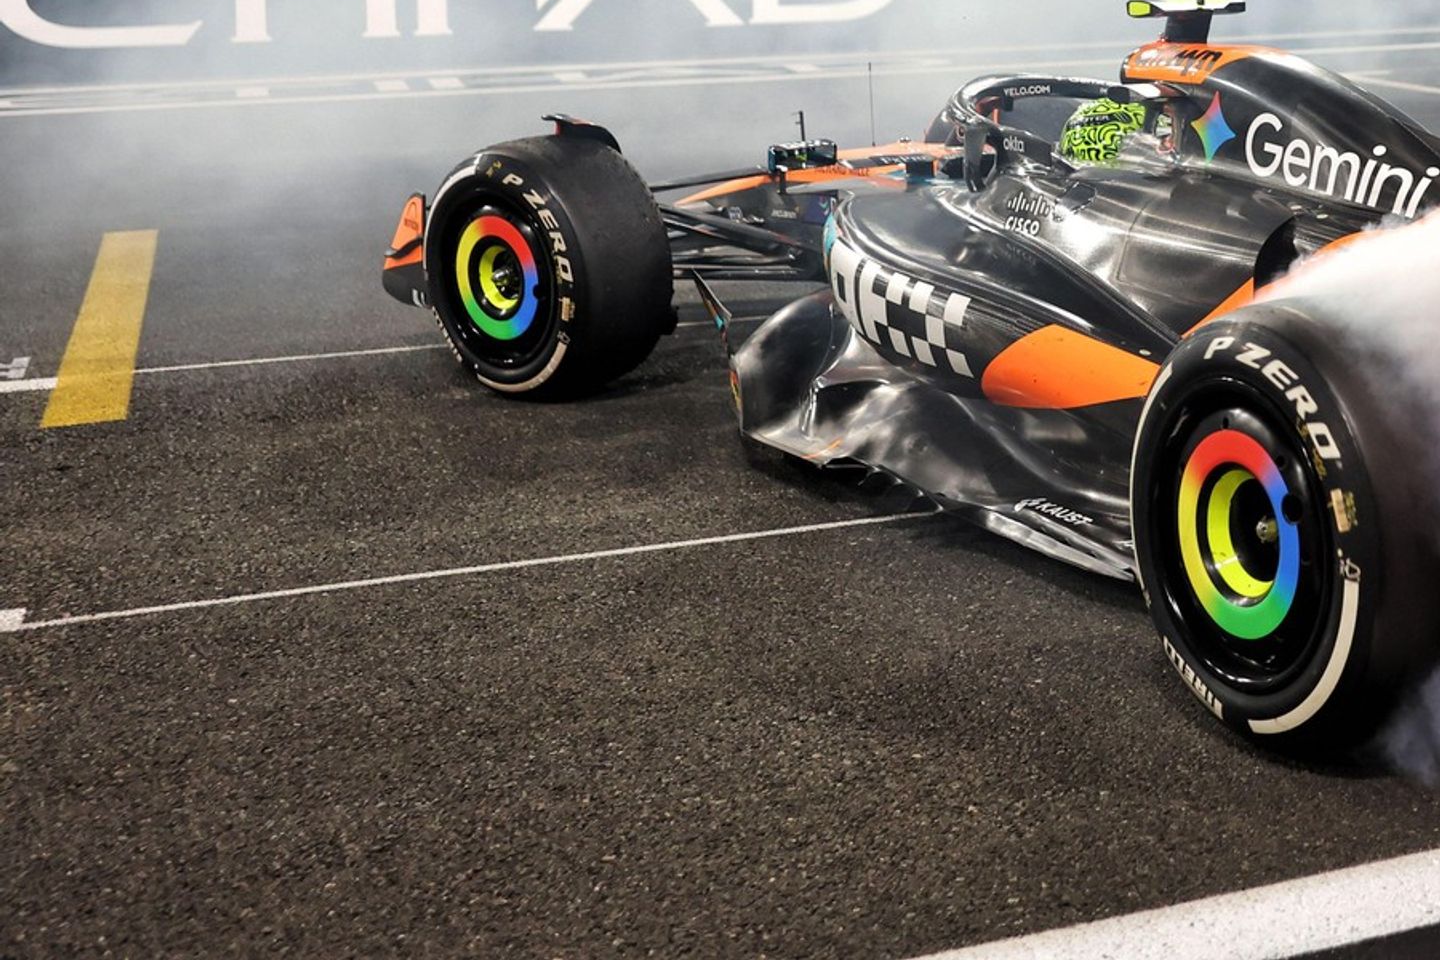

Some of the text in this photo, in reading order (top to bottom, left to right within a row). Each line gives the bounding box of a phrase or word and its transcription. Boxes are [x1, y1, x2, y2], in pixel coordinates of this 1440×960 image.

[1003, 137, 1025, 153] okta
[1245, 112, 1440, 219] Gemini
[502, 172, 523, 187] P
[522, 188, 574, 289] ZERO
[1203, 336, 1236, 359] P
[1235, 342, 1341, 459] ZERO
[1035, 499, 1094, 526] KAUST
